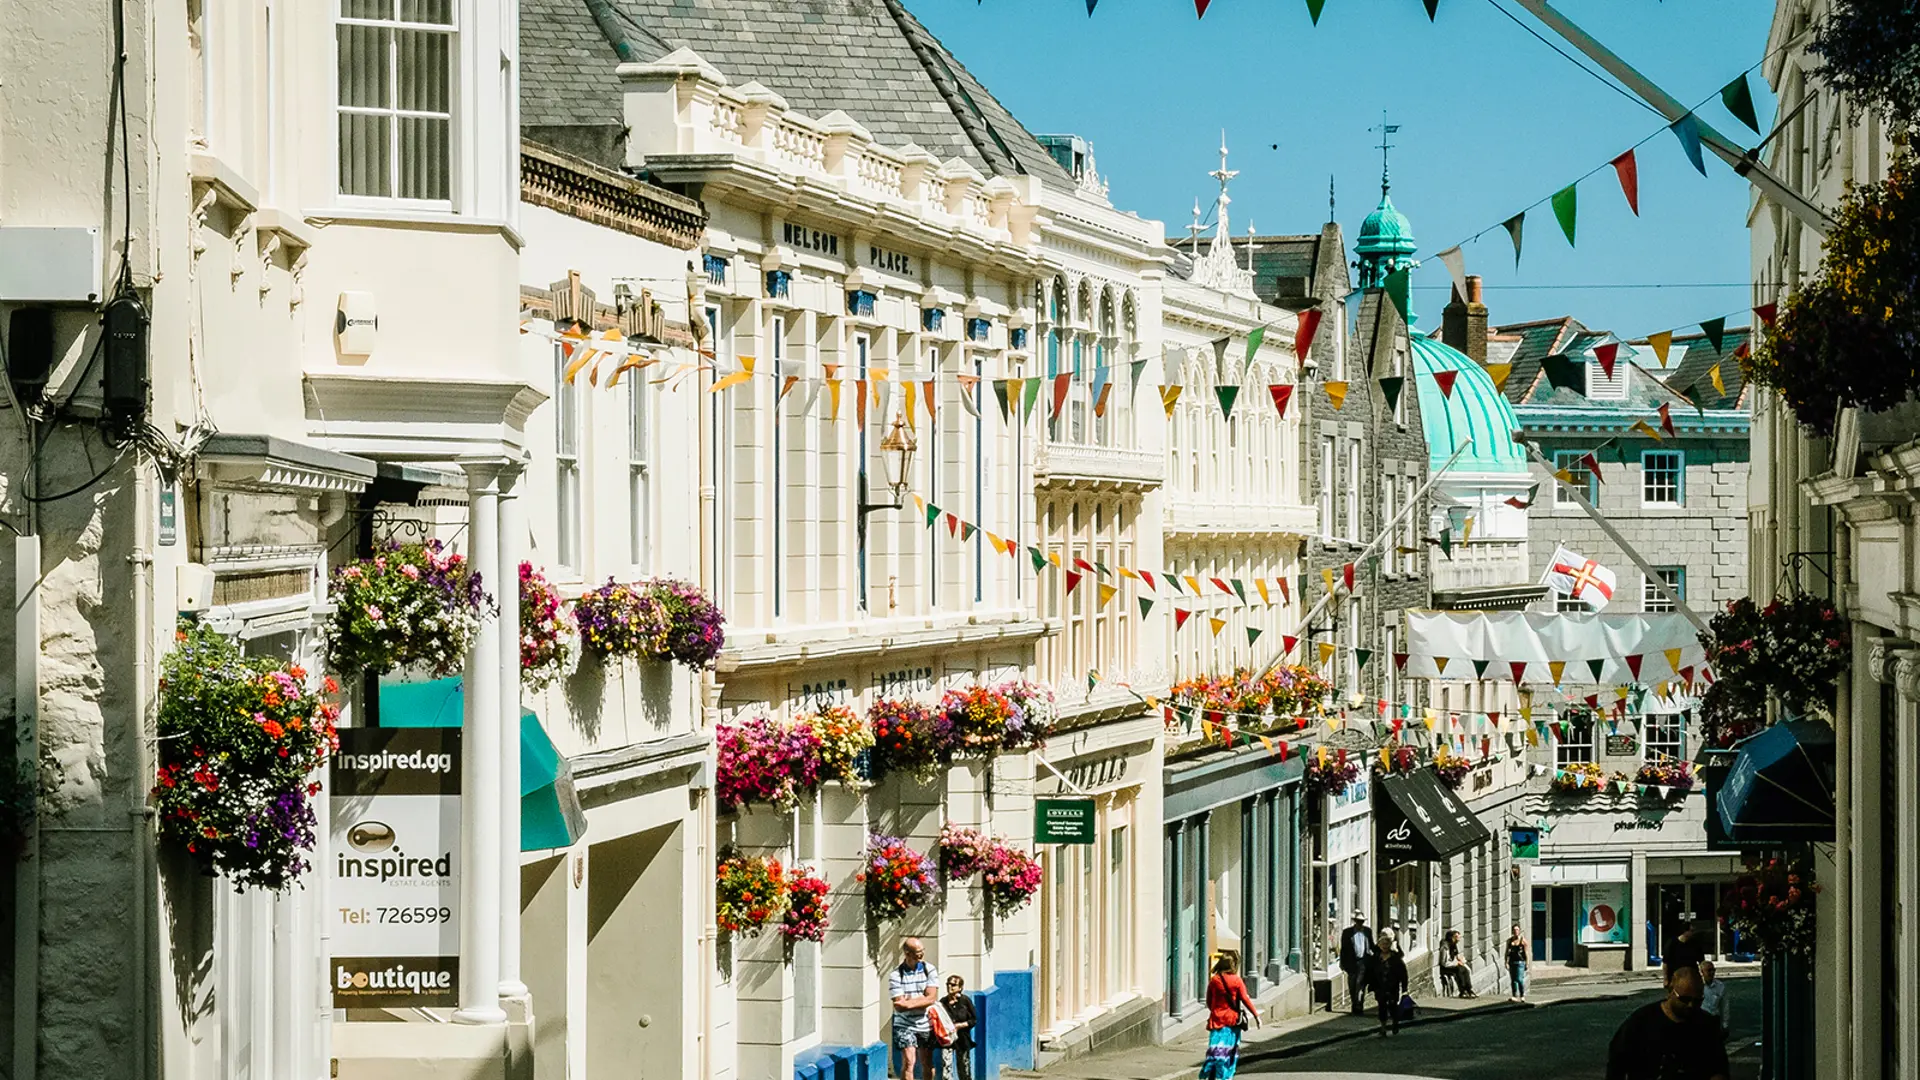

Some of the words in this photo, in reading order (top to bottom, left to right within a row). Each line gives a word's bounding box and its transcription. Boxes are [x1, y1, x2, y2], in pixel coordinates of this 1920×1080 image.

[784, 222, 837, 255] NELSON
[338, 750, 451, 773] inspired.gg
[1047, 809, 1084, 817] LOVELLS
[1387, 819, 1411, 841] ab
[1614, 820, 1664, 832] pharmacy
[338, 851, 451, 883] inspired
[339, 908, 371, 924] Tel:
[377, 907, 450, 924] 726599
[337, 965, 451, 994] boutique
